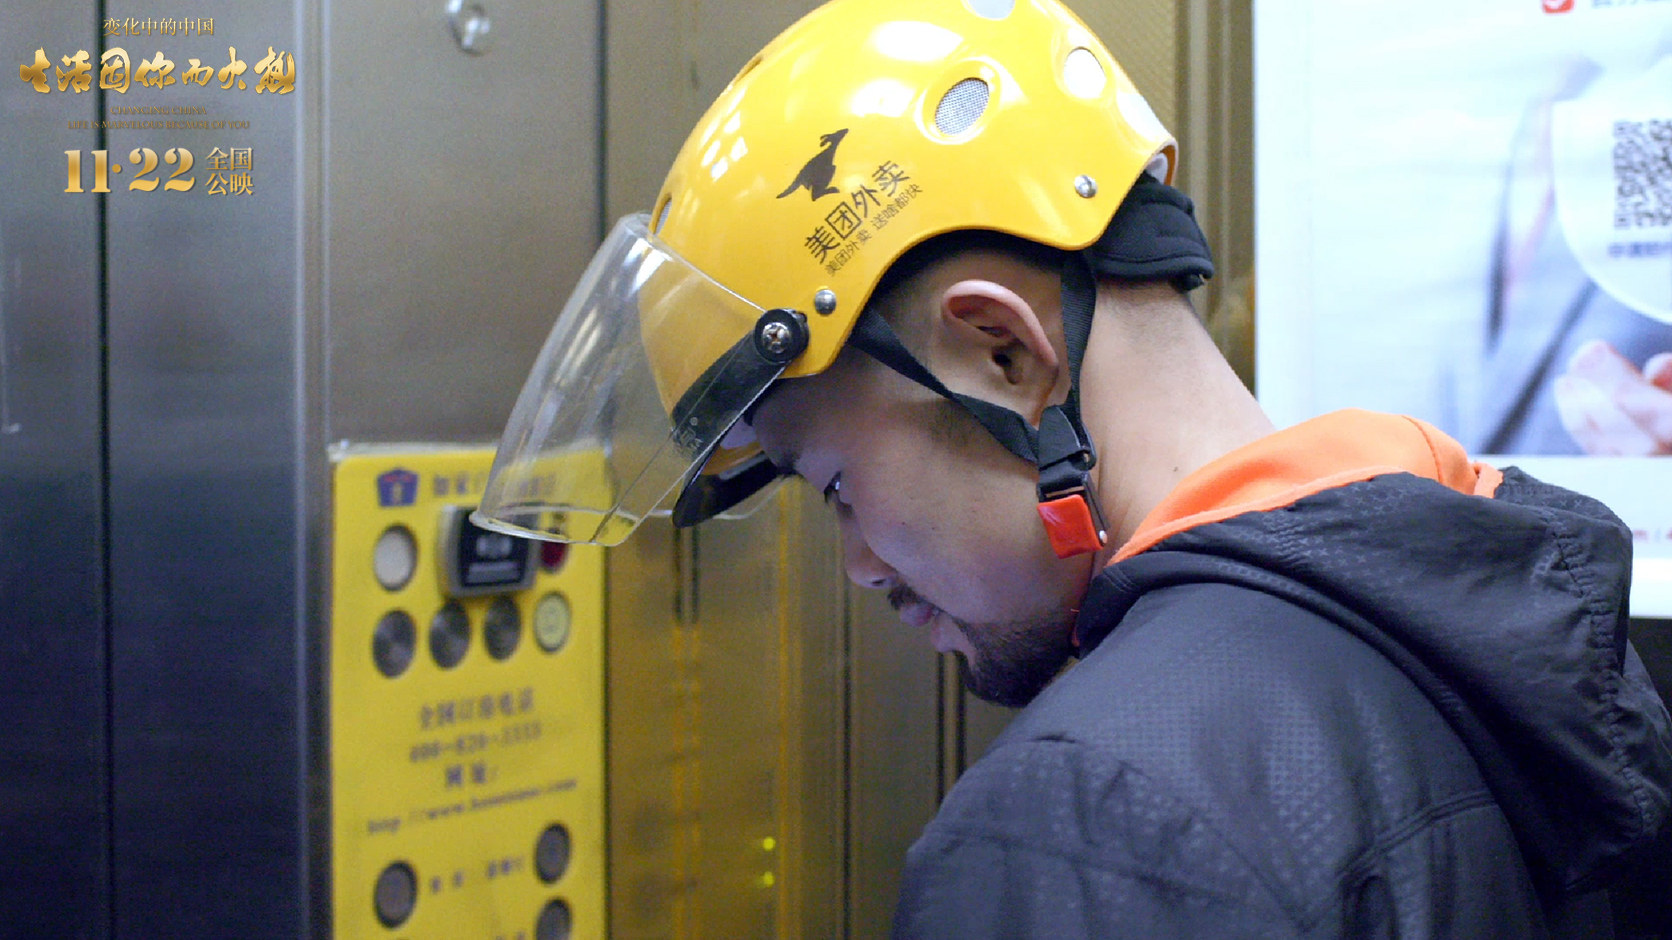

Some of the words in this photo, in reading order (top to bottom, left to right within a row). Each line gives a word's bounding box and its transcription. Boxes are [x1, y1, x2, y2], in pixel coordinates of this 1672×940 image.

[804, 160, 910, 264] 美团外卖
[825, 229, 872, 276] 美团外卖
[870, 183, 923, 230] 送啥都快
